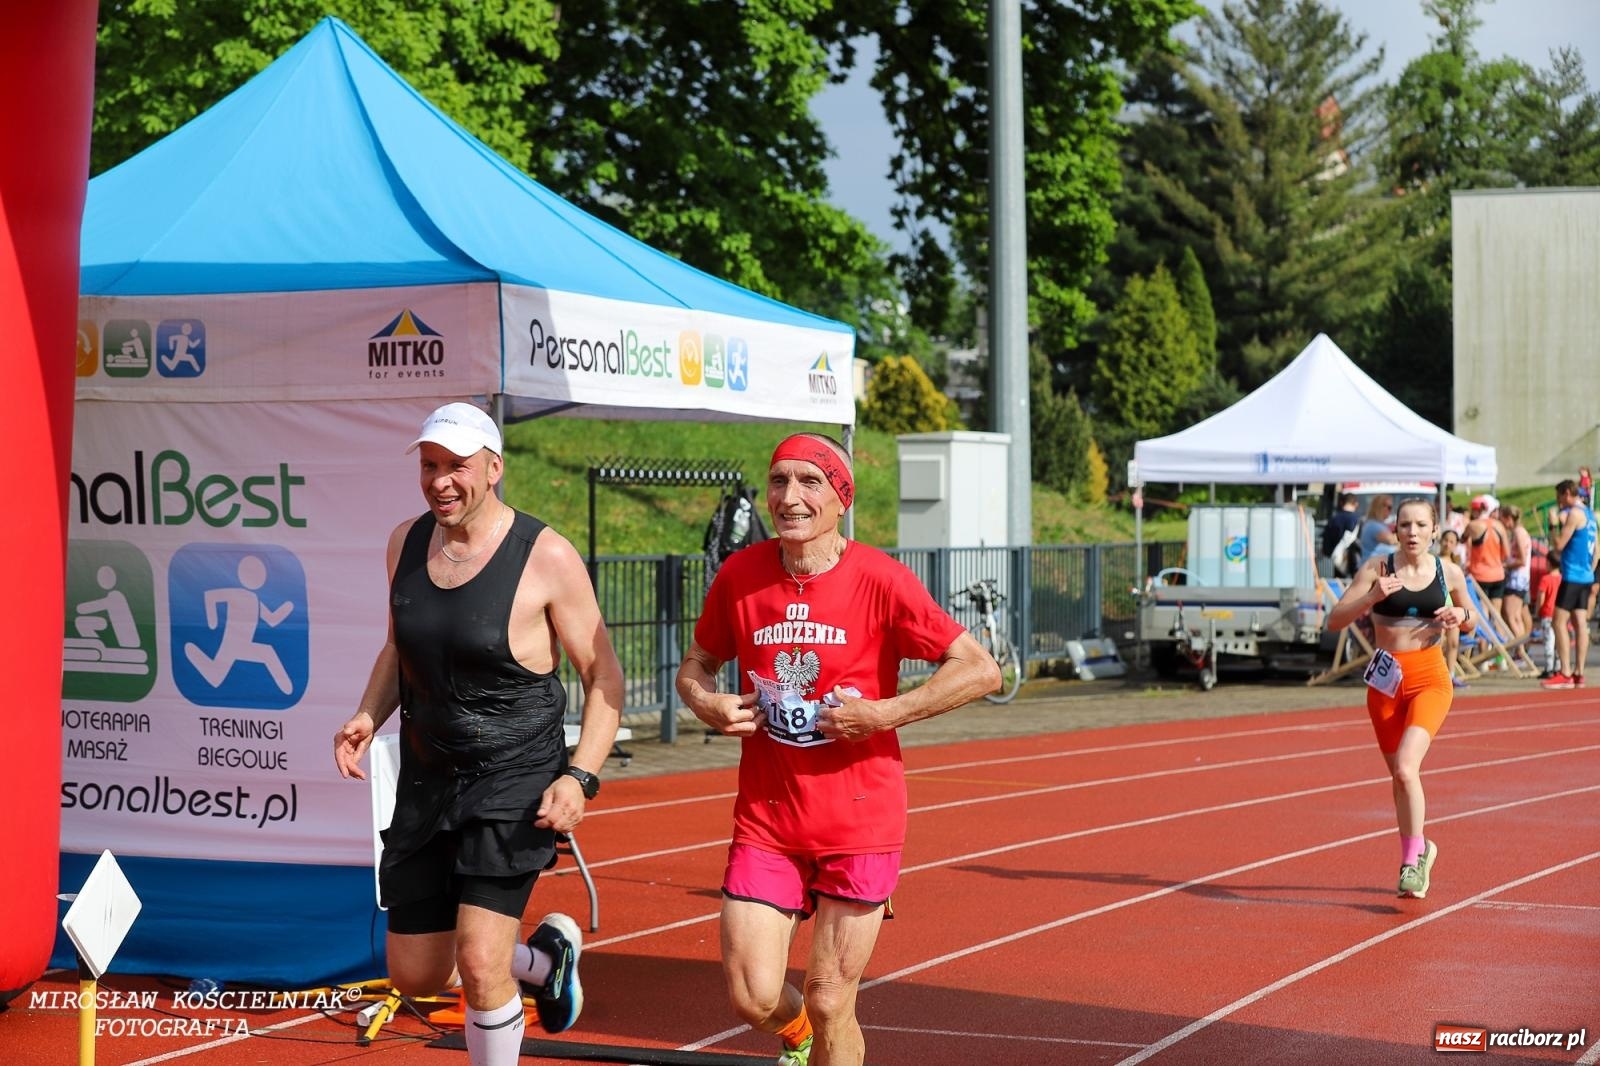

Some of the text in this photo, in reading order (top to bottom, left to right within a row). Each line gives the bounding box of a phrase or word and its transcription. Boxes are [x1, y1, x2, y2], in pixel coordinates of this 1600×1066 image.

[368, 340, 444, 367] MITKO
[530, 319, 672, 378] PersonalBest
[368, 369, 445, 379] for events
[808, 373, 837, 395] MITKO
[786, 603, 810, 621] OD
[753, 621, 847, 646] URODZENIA
[199, 717, 284, 740] TRENINGI
[66, 738, 128, 761] MASAŻ
[197, 747, 288, 771] BIEGOWE
